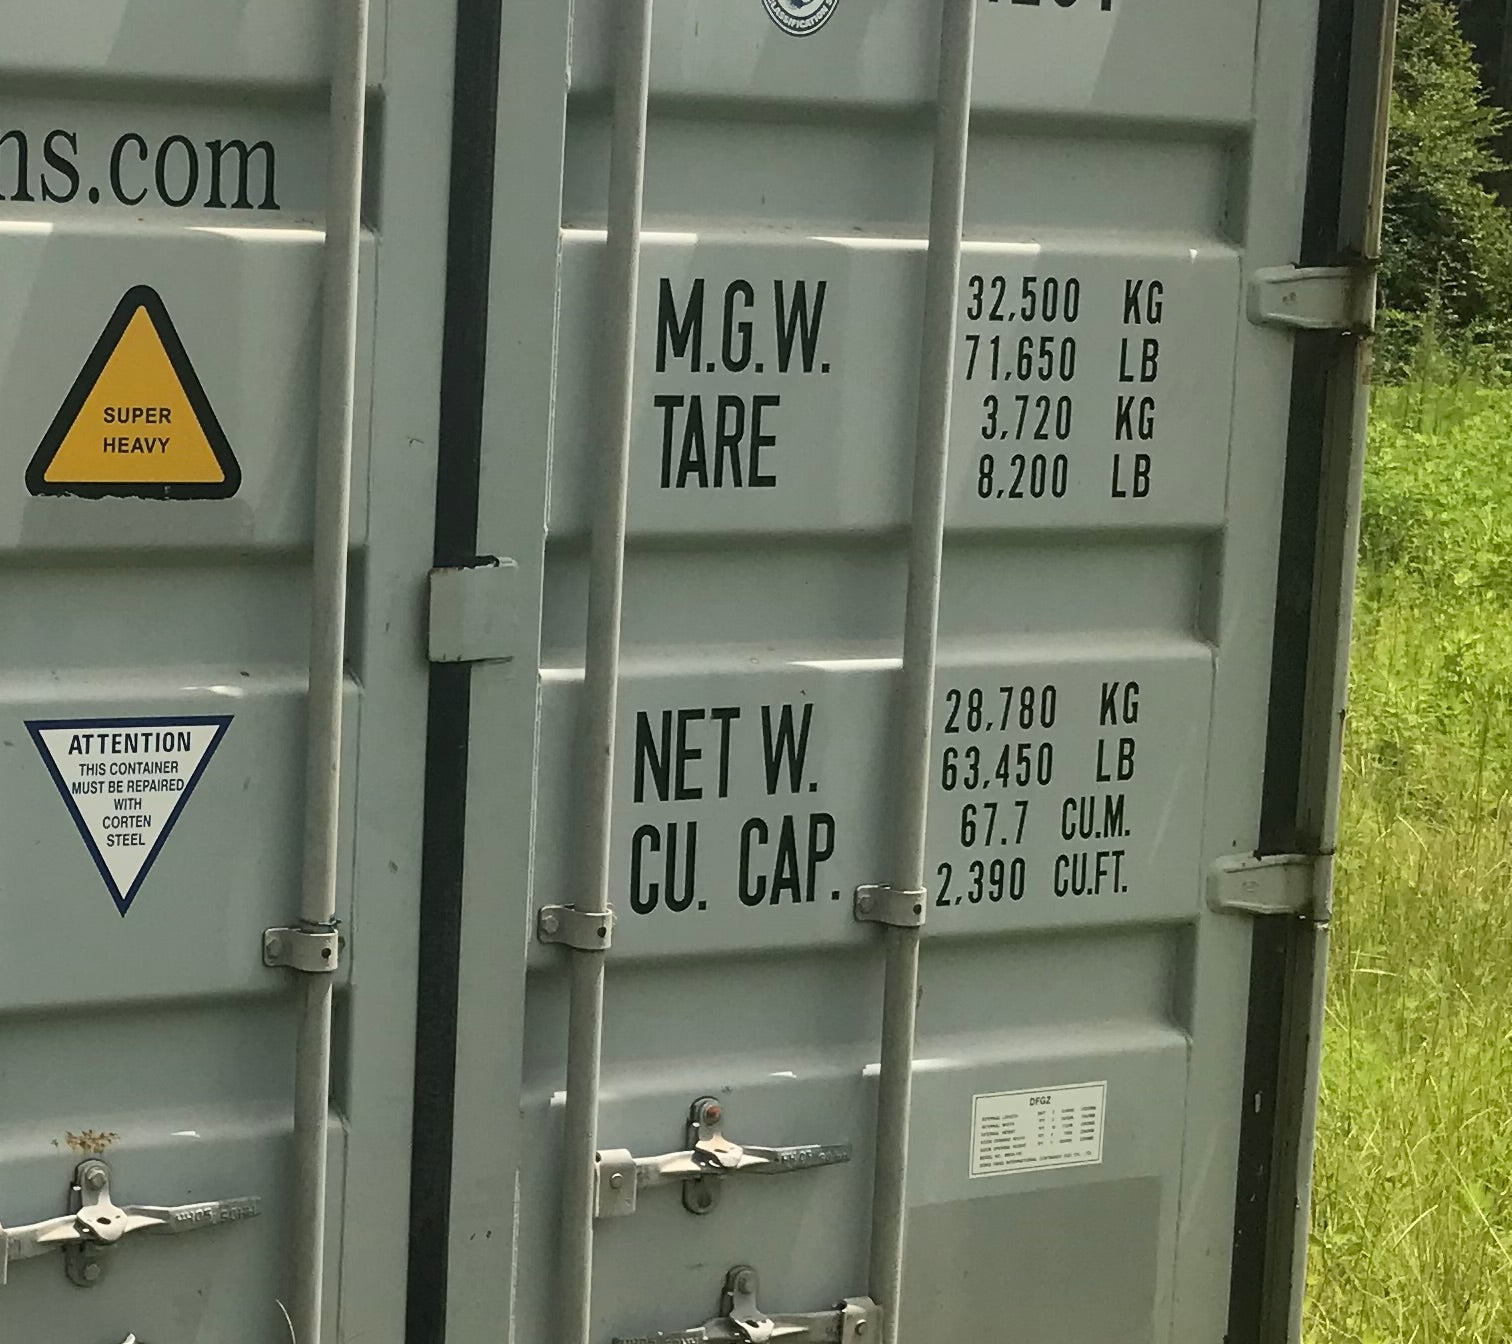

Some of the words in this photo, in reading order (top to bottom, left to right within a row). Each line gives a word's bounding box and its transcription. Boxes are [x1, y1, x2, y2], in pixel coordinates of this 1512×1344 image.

[967, 275, 1080, 323] 32,500
[1123, 279, 1164, 324] KG
[655, 278, 830, 374] M.G.W.
[965, 335, 1076, 381] 71,650
[1119, 337, 1160, 383] LB
[103, 407, 172, 424] SUPER
[981, 394, 1072, 440] 3,720
[1115, 395, 1155, 441] KG
[103, 437, 170, 453] HEAVY
[654, 394, 781, 489] TARE
[978, 453, 1068, 499] 8,200
[1111, 453, 1151, 498] LB
[944, 684, 1057, 734] 28,780
[1099, 681, 1140, 726] KG
[68, 732, 191, 755] ATTENTION
[633, 706, 740, 803] NET
[760, 703, 818, 796] W.
[941, 742, 1053, 791] 63,450
[1096, 737, 1136, 782] LB
[72, 781, 105, 794] MUST
[108, 781, 123, 793] BE
[127, 779, 185, 792] REPAIRED
[79, 763, 106, 776] THIS
[110, 761, 178, 775] CONTAINER
[102, 815, 151, 829] CORTEN
[114, 798, 142, 810] WITH
[960, 800, 1029, 848] 67.7
[1061, 794, 1131, 841] CU.M.
[106, 834, 146, 847] STEEL
[630, 821, 707, 915] CU.
[738, 812, 840, 907] CAP.
[936, 857, 1026, 907] 2,390
[1054, 850, 1128, 897] CU.FT.
